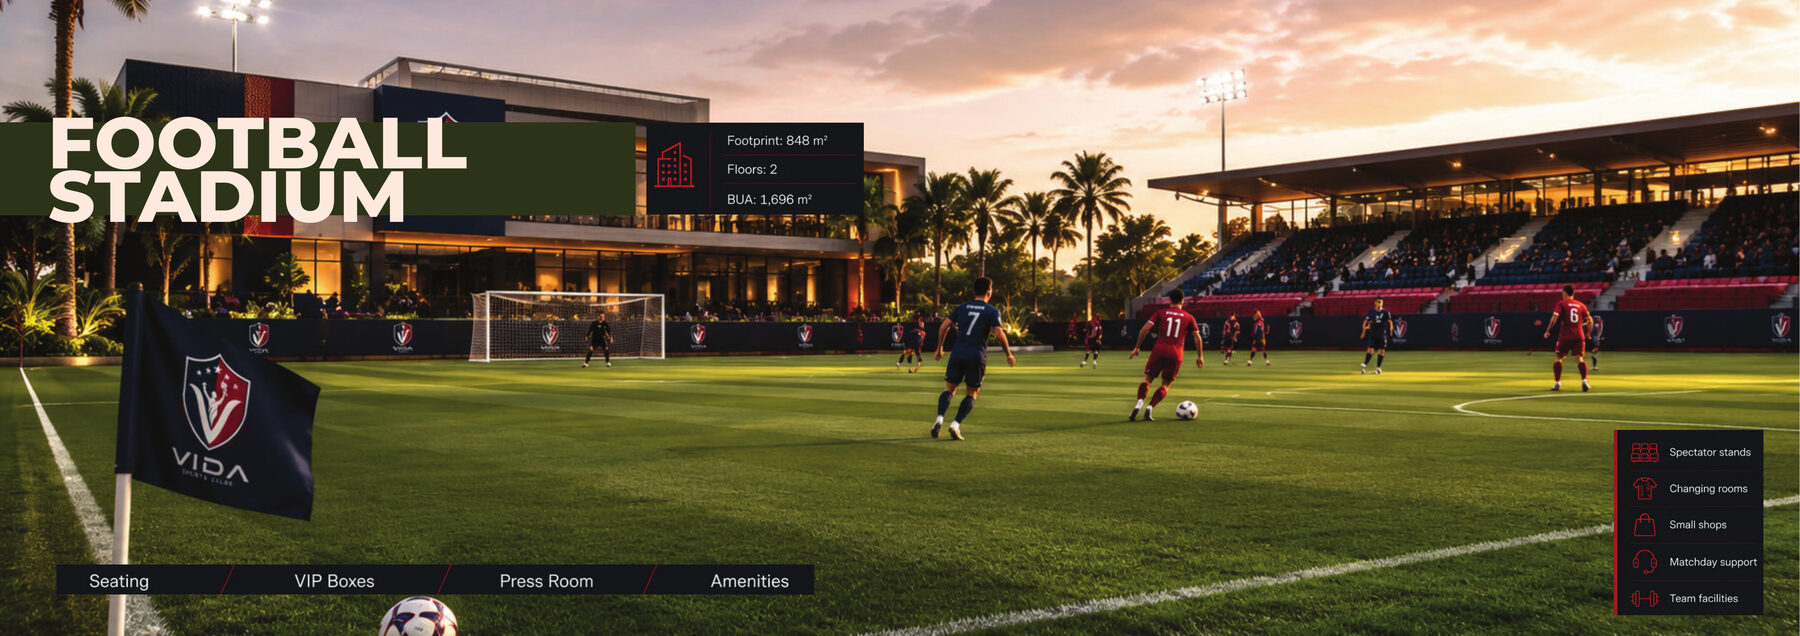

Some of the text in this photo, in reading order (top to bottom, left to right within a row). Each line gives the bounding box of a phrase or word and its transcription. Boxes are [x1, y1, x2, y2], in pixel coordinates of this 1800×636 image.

[966, 311, 980, 336] 7
[1570, 307, 1580, 323] 6
[1166, 316, 1181, 338] 11
[172, 447, 249, 483] VIDA
